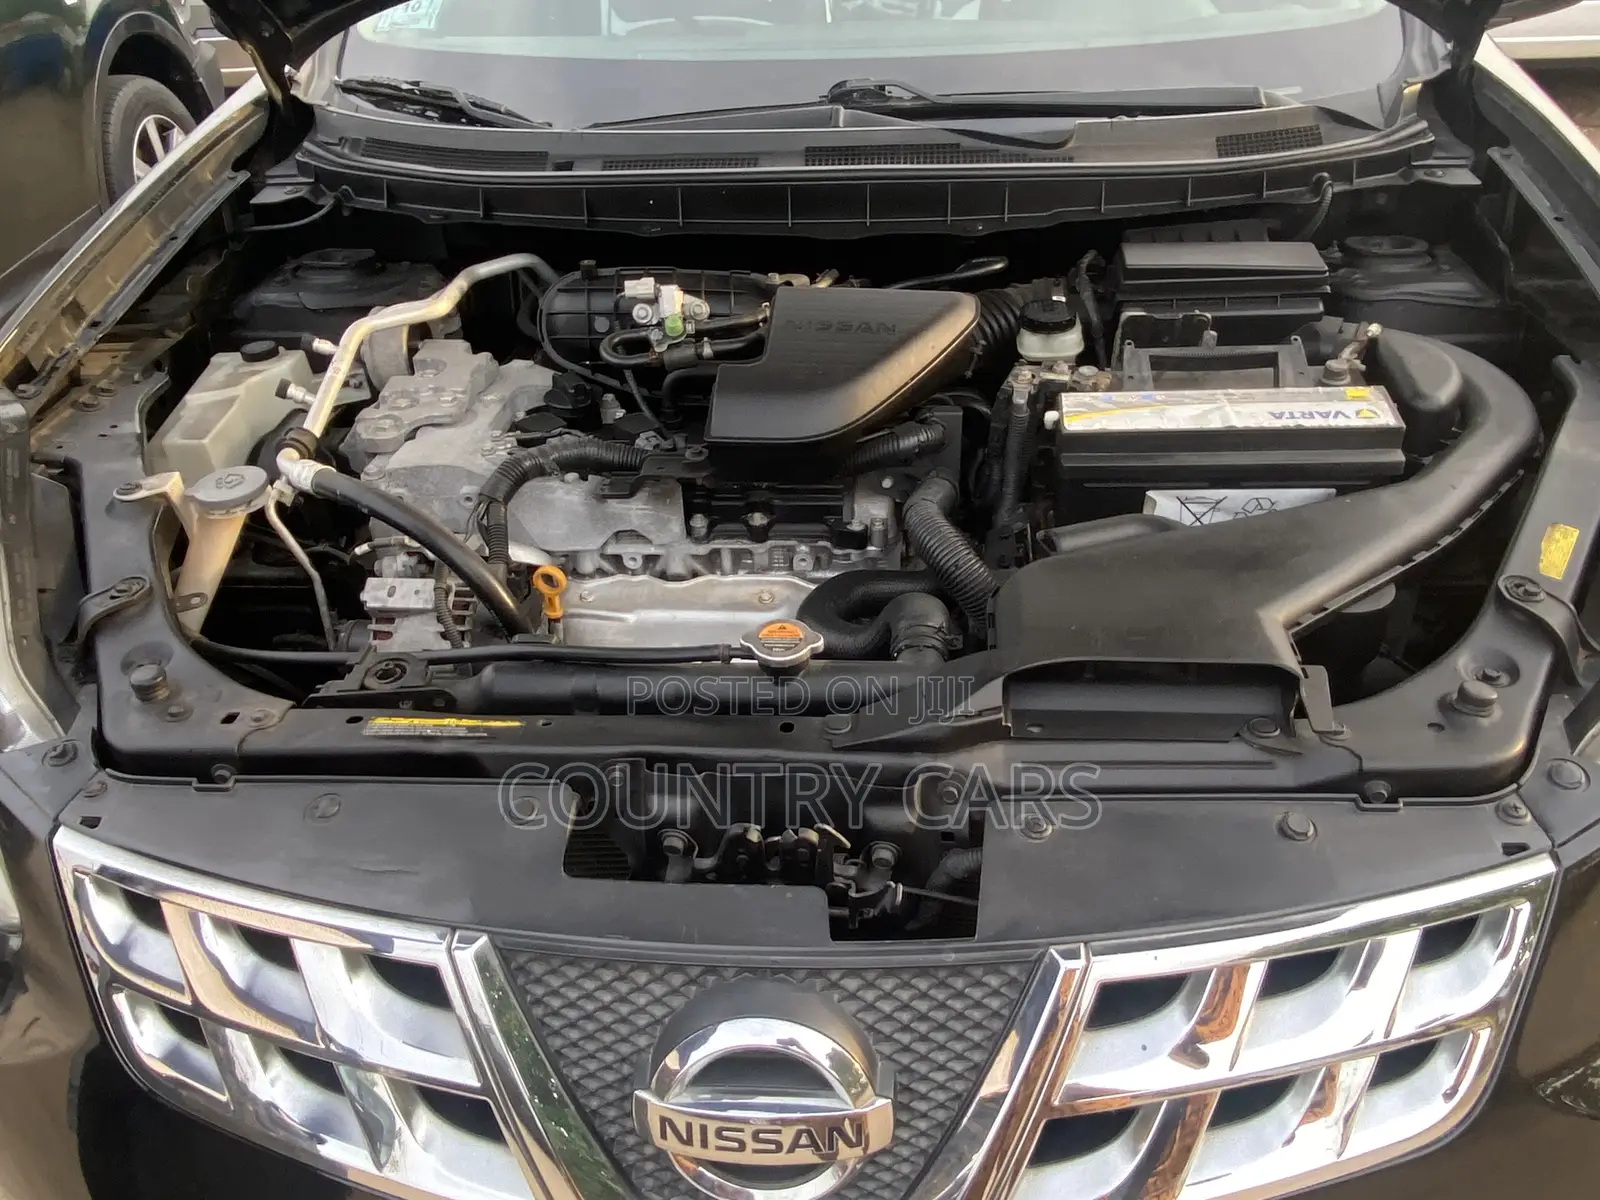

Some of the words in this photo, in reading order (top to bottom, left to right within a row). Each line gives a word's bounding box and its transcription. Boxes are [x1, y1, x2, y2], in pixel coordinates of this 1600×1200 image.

[785, 320, 897, 335] NISSAN
[1267, 410, 1352, 420] VARTA
[658, 1114, 865, 1155] NISSAN
